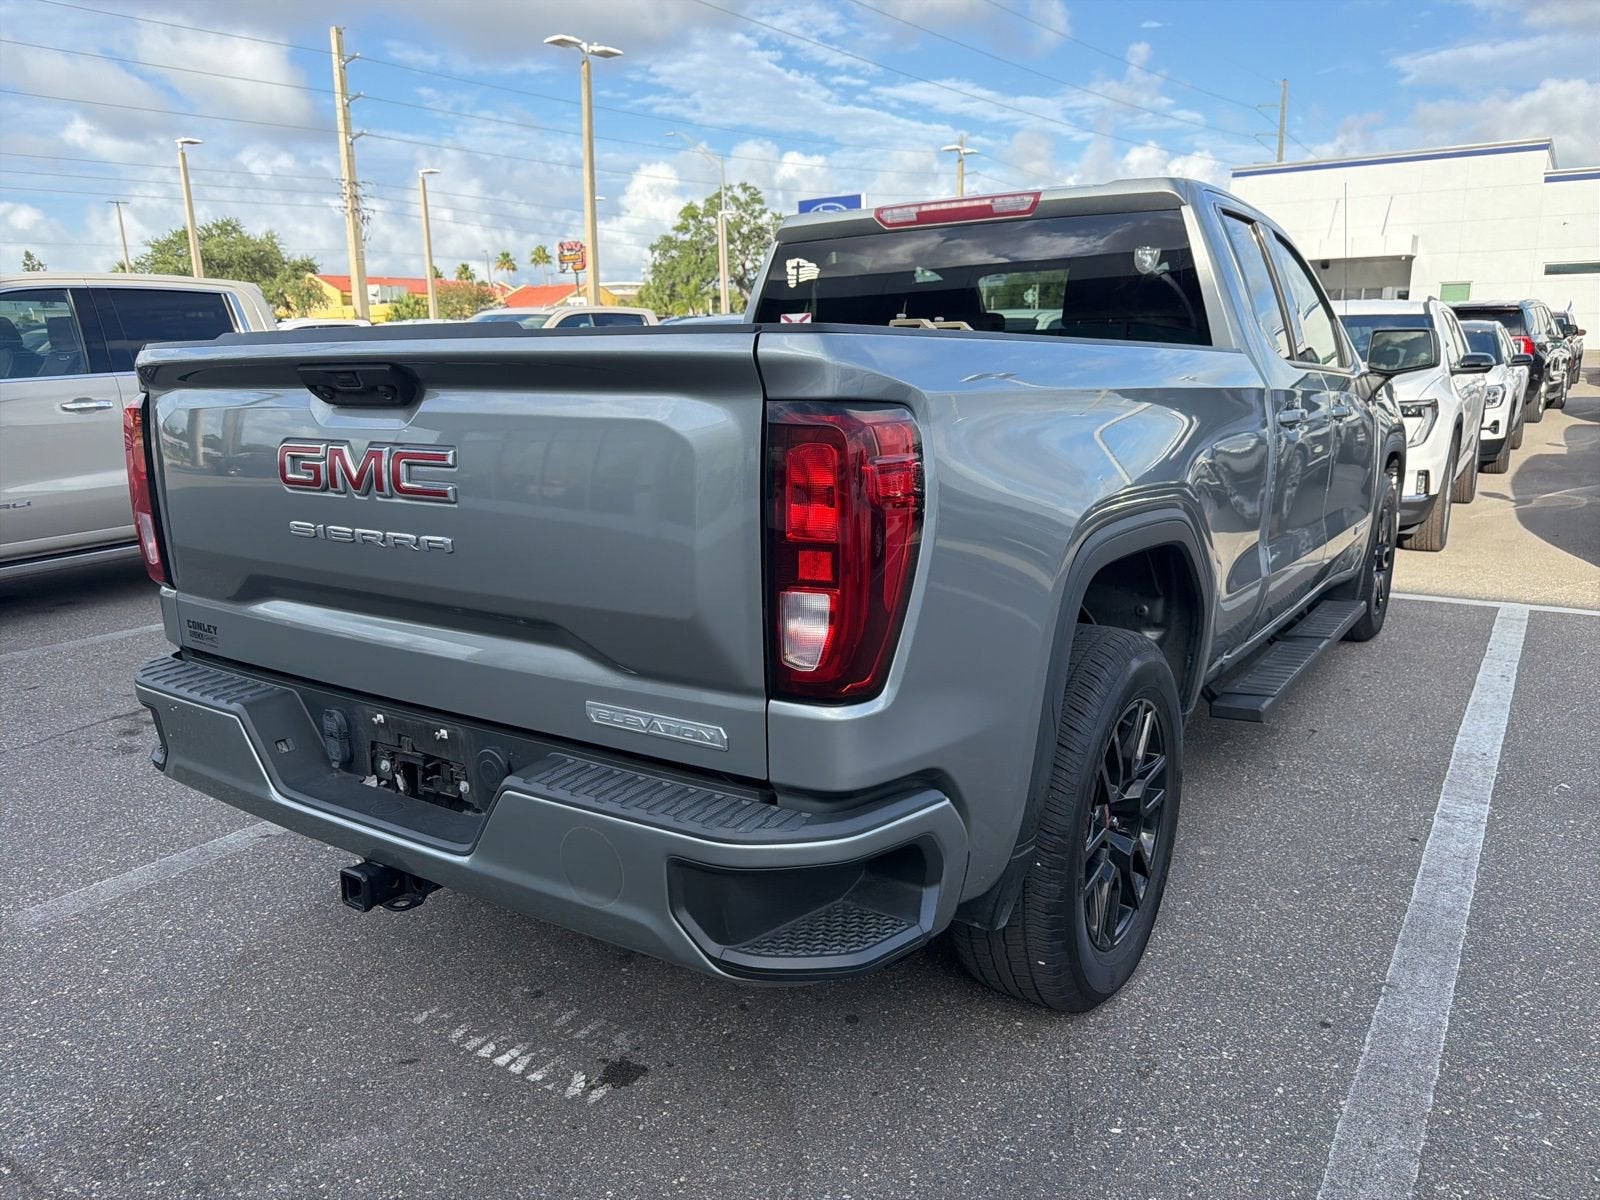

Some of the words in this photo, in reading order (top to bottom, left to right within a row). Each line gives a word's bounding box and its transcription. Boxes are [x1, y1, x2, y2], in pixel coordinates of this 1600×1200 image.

[278, 442, 457, 504] GMC
[289, 520, 455, 553] SIERRA
[187, 619, 218, 635] CONLEY
[597, 708, 719, 744] ELEVATION
